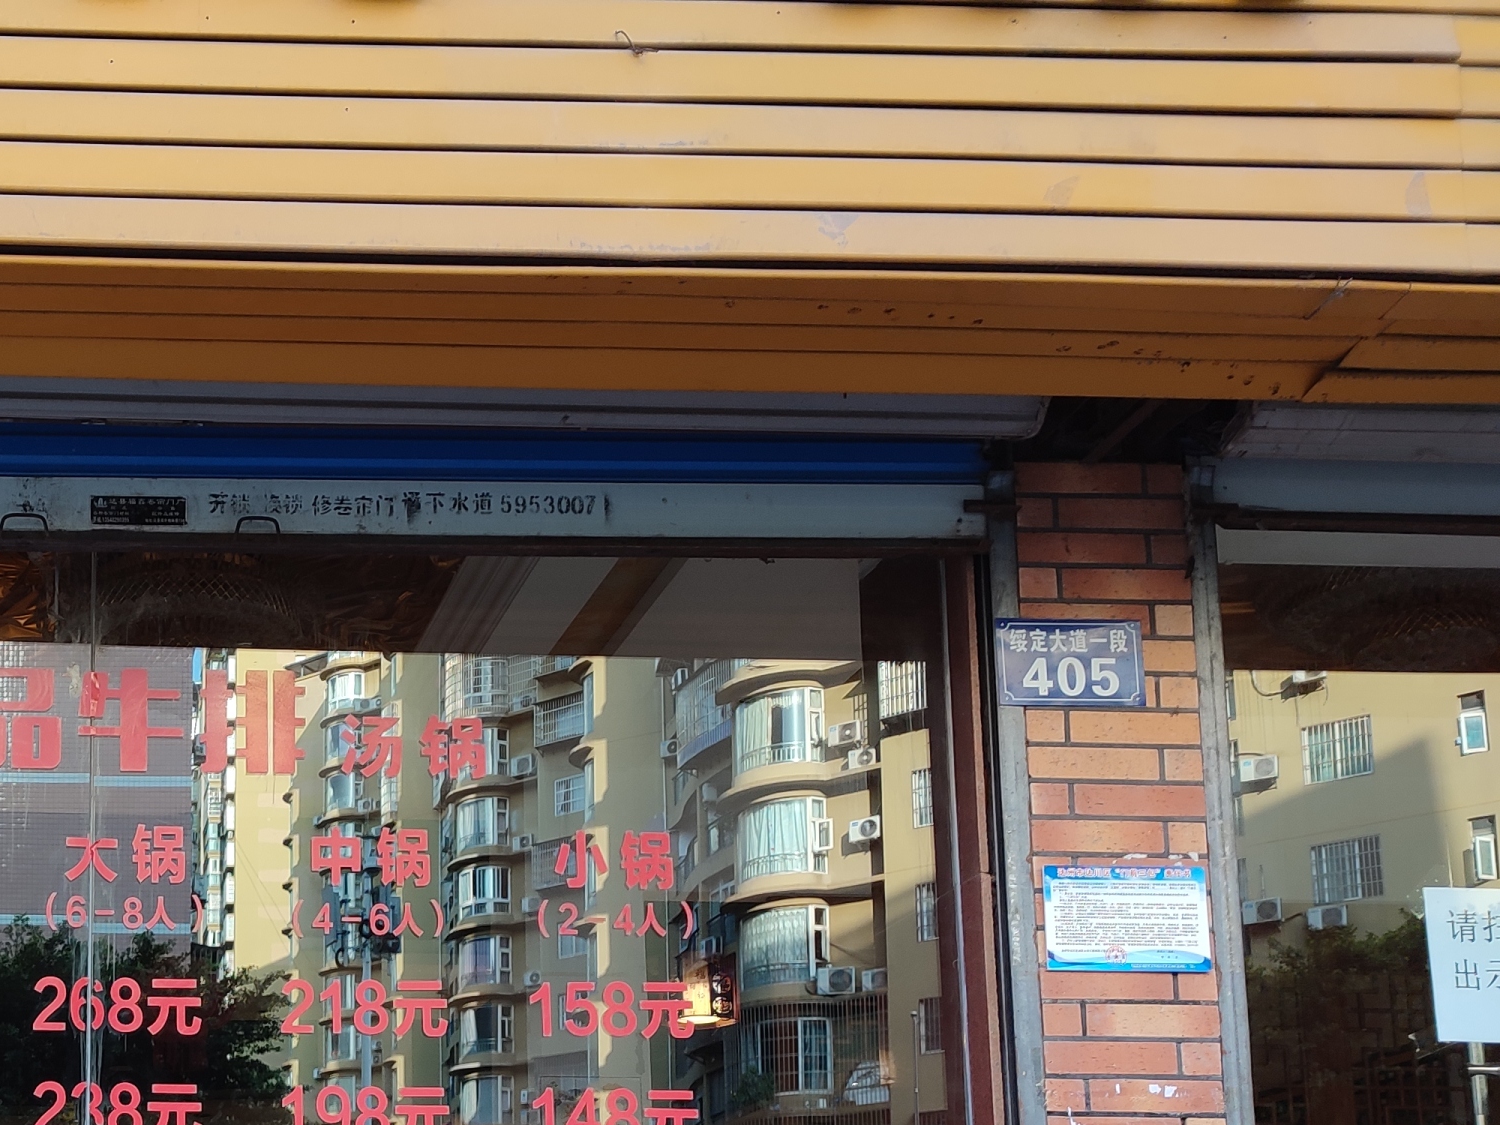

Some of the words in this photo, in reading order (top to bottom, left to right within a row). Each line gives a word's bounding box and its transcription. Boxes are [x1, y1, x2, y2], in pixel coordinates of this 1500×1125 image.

[500, 494, 596, 515] 5953007
[1009, 628, 1129, 653] 绥定大道一段
[1022, 656, 1120, 697] 405
[64, 823, 187, 885] 大锅
[310, 826, 431, 887] 中锅
[554, 829, 674, 891] 小锅
[32, 975, 203, 1036] 268元
[279, 978, 449, 1038] 218元
[529, 981, 697, 1040] 158元
